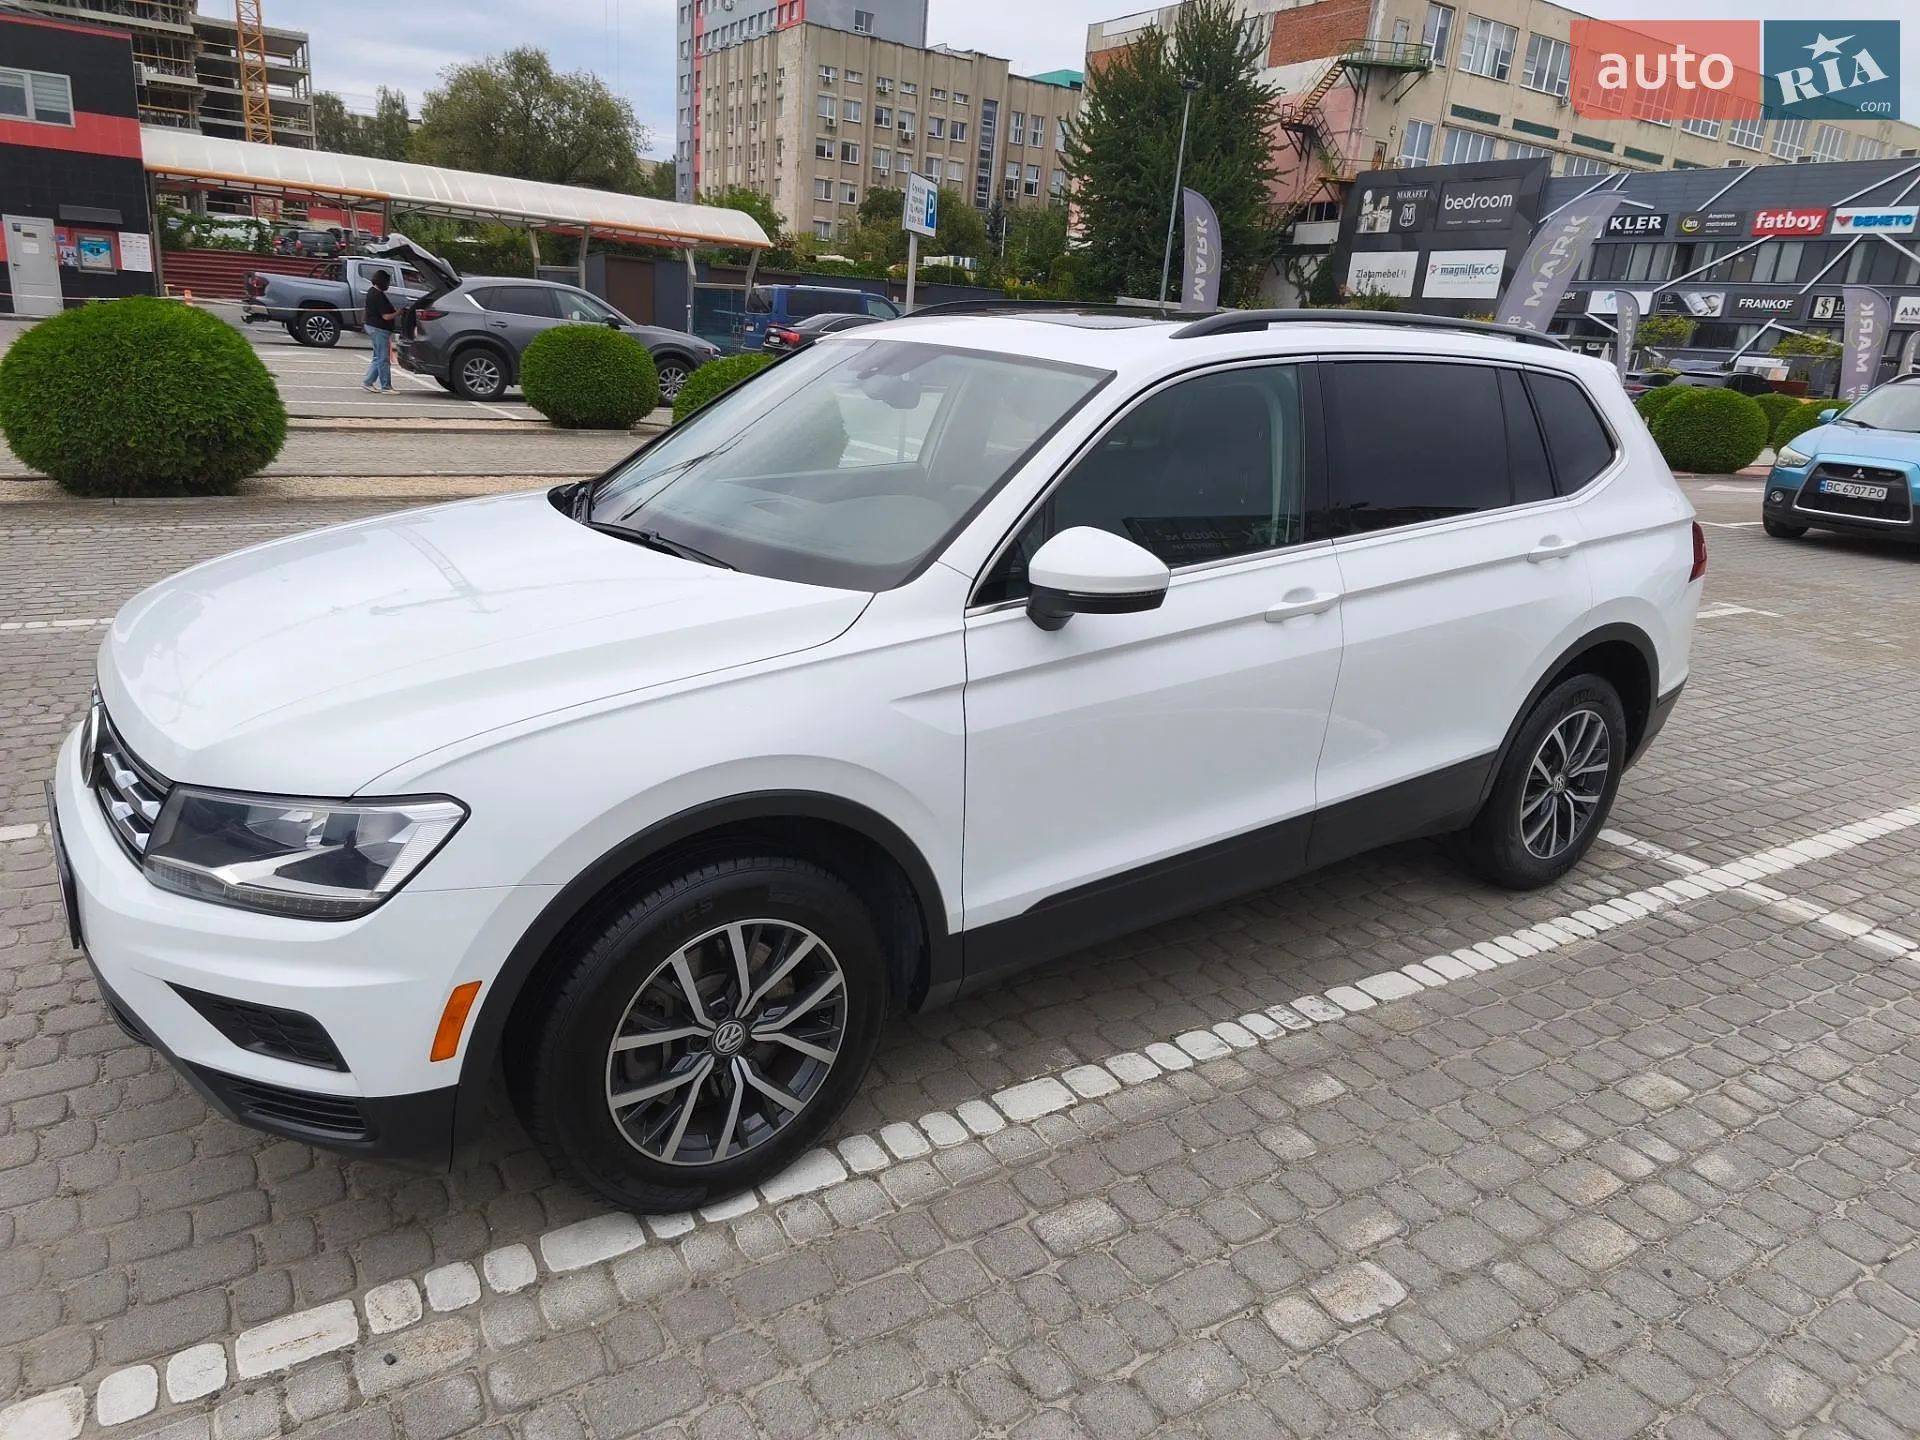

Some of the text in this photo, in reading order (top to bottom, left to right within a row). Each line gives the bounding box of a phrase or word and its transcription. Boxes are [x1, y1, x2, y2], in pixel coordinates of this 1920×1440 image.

[1444, 193, 1513, 210] bedroom
[1609, 216, 1662, 230] KLER
[1523, 215, 1590, 308] MARK
[1738, 298, 1794, 309] FRANKOF
[1900, 306, 1920, 316] AN
[1826, 481, 1842, 492] BC
[1842, 484, 1868, 496] 6707
